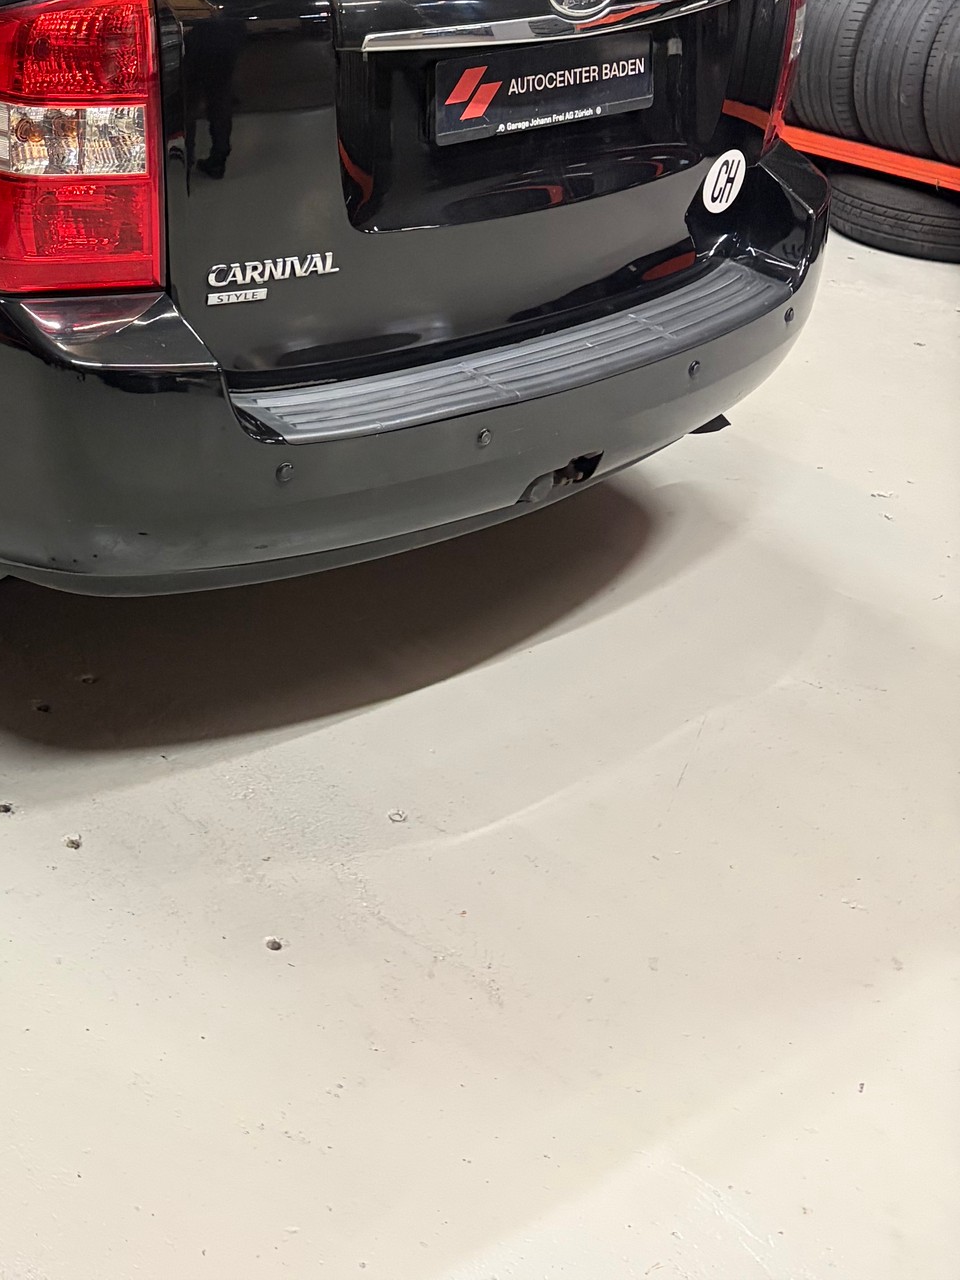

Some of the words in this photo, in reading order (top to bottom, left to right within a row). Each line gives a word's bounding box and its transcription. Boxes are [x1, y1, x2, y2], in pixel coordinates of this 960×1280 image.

[507, 65, 599, 96] AUTOCENTER
[602, 57, 645, 80] BADEN
[506, 121, 529, 132] Garage
[529, 117, 552, 127] Johann
[552, 113, 565, 122] Frei
[565, 111, 574, 120] AG
[574, 107, 594, 118] Zürich
[710, 158, 741, 204] CH
[207, 251, 340, 287] CARNIVAL
[216, 291, 259, 304] STYLE
